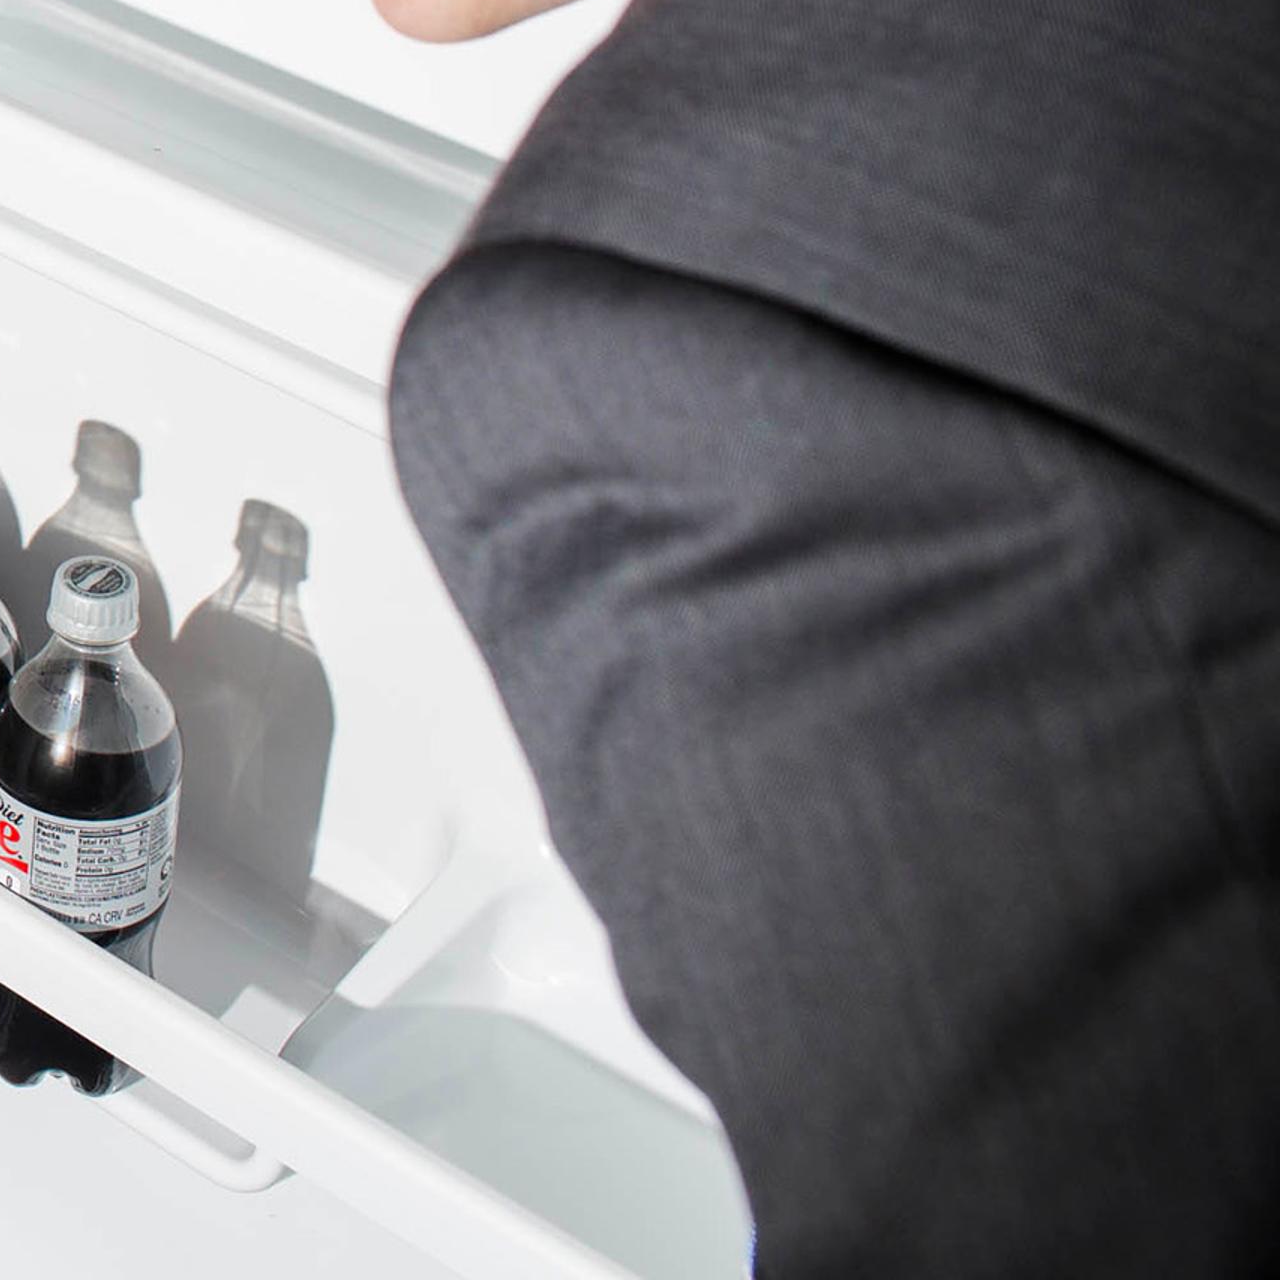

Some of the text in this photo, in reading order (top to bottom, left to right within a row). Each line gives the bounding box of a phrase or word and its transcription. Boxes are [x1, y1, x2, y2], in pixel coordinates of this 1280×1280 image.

[37, 828, 60, 840] Facts
[38, 820, 76, 835] Nutrition
[35, 854, 61, 867] Calories
[90, 911, 103, 924] CA
[104, 908, 124, 922] CRV
